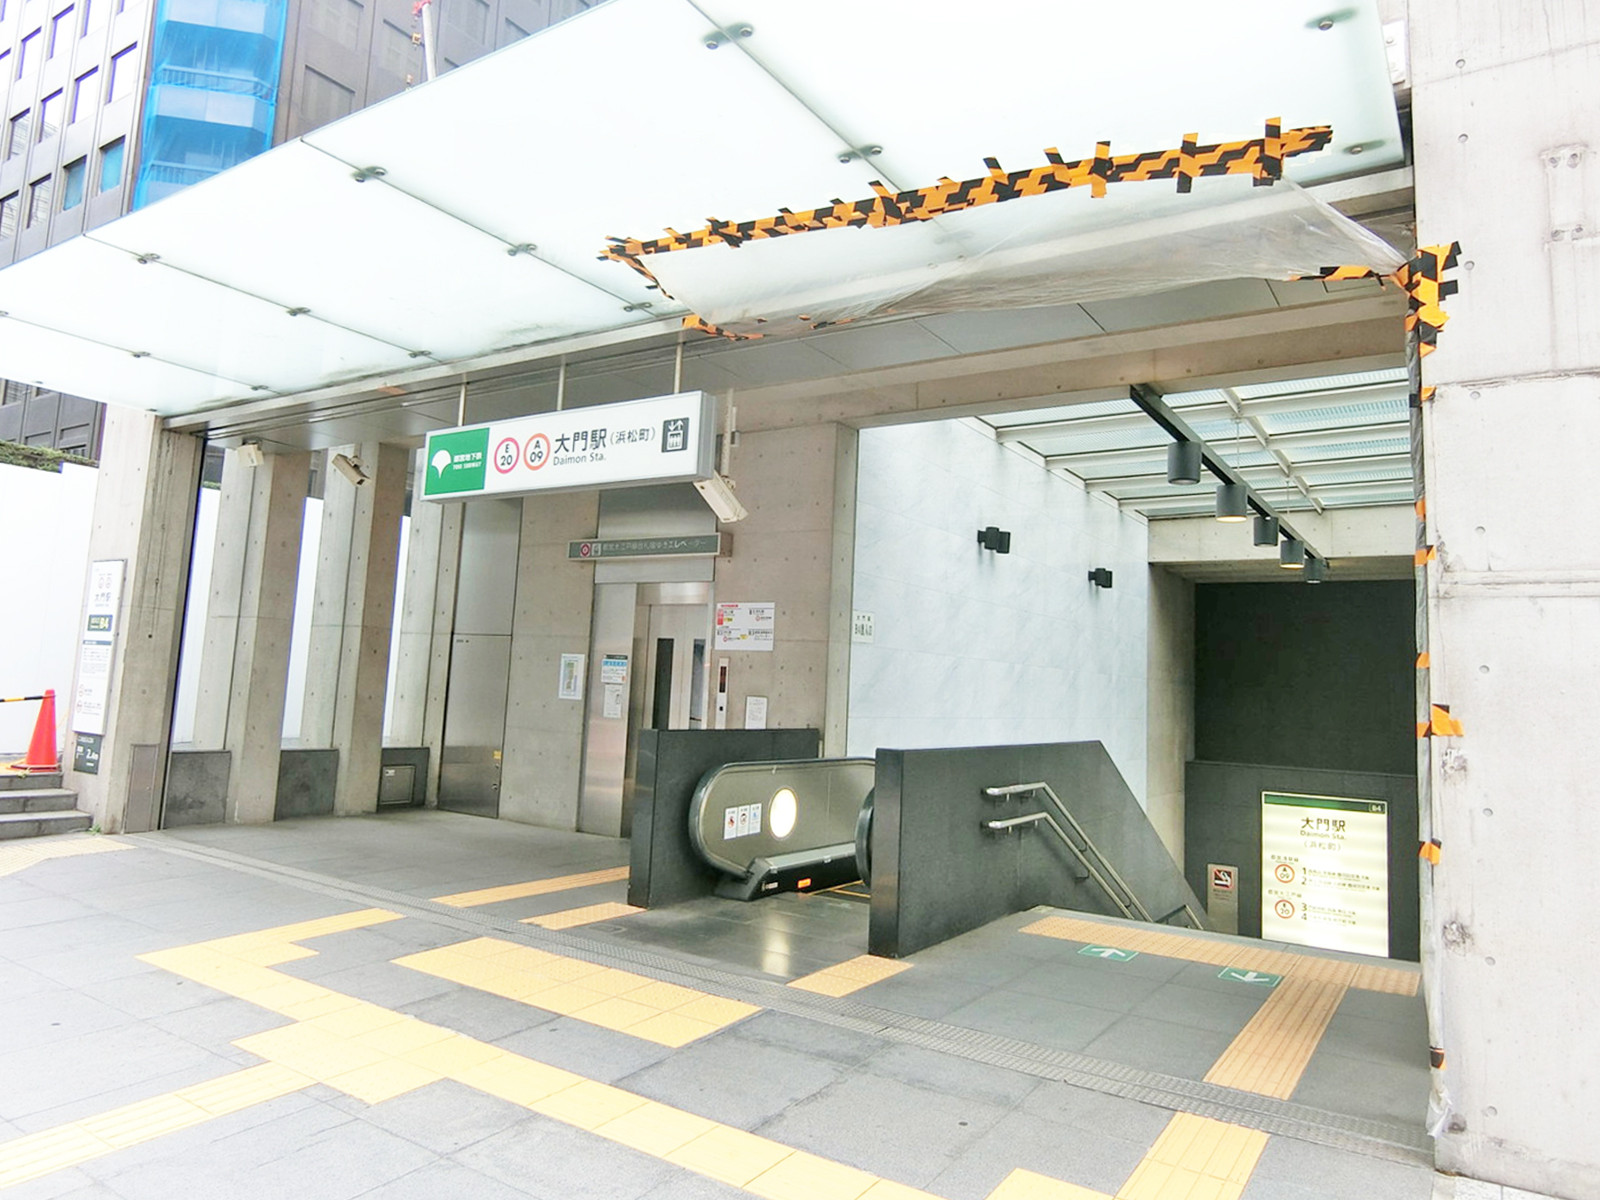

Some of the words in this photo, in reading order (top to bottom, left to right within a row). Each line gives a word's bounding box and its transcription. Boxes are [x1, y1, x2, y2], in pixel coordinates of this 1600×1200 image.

[534, 440, 541, 449] A
[554, 428, 607, 454] 大門駅
[505, 443, 510, 453] E
[500, 454, 513, 466] 20
[529, 450, 544, 463] 09
[553, 454, 587, 466] Daimon
[589, 452, 606, 462] Sta.
[1371, 804, 1381, 812] B4
[1301, 817, 1346, 833] 大門駅
[1300, 830, 1330, 838] Daimon
